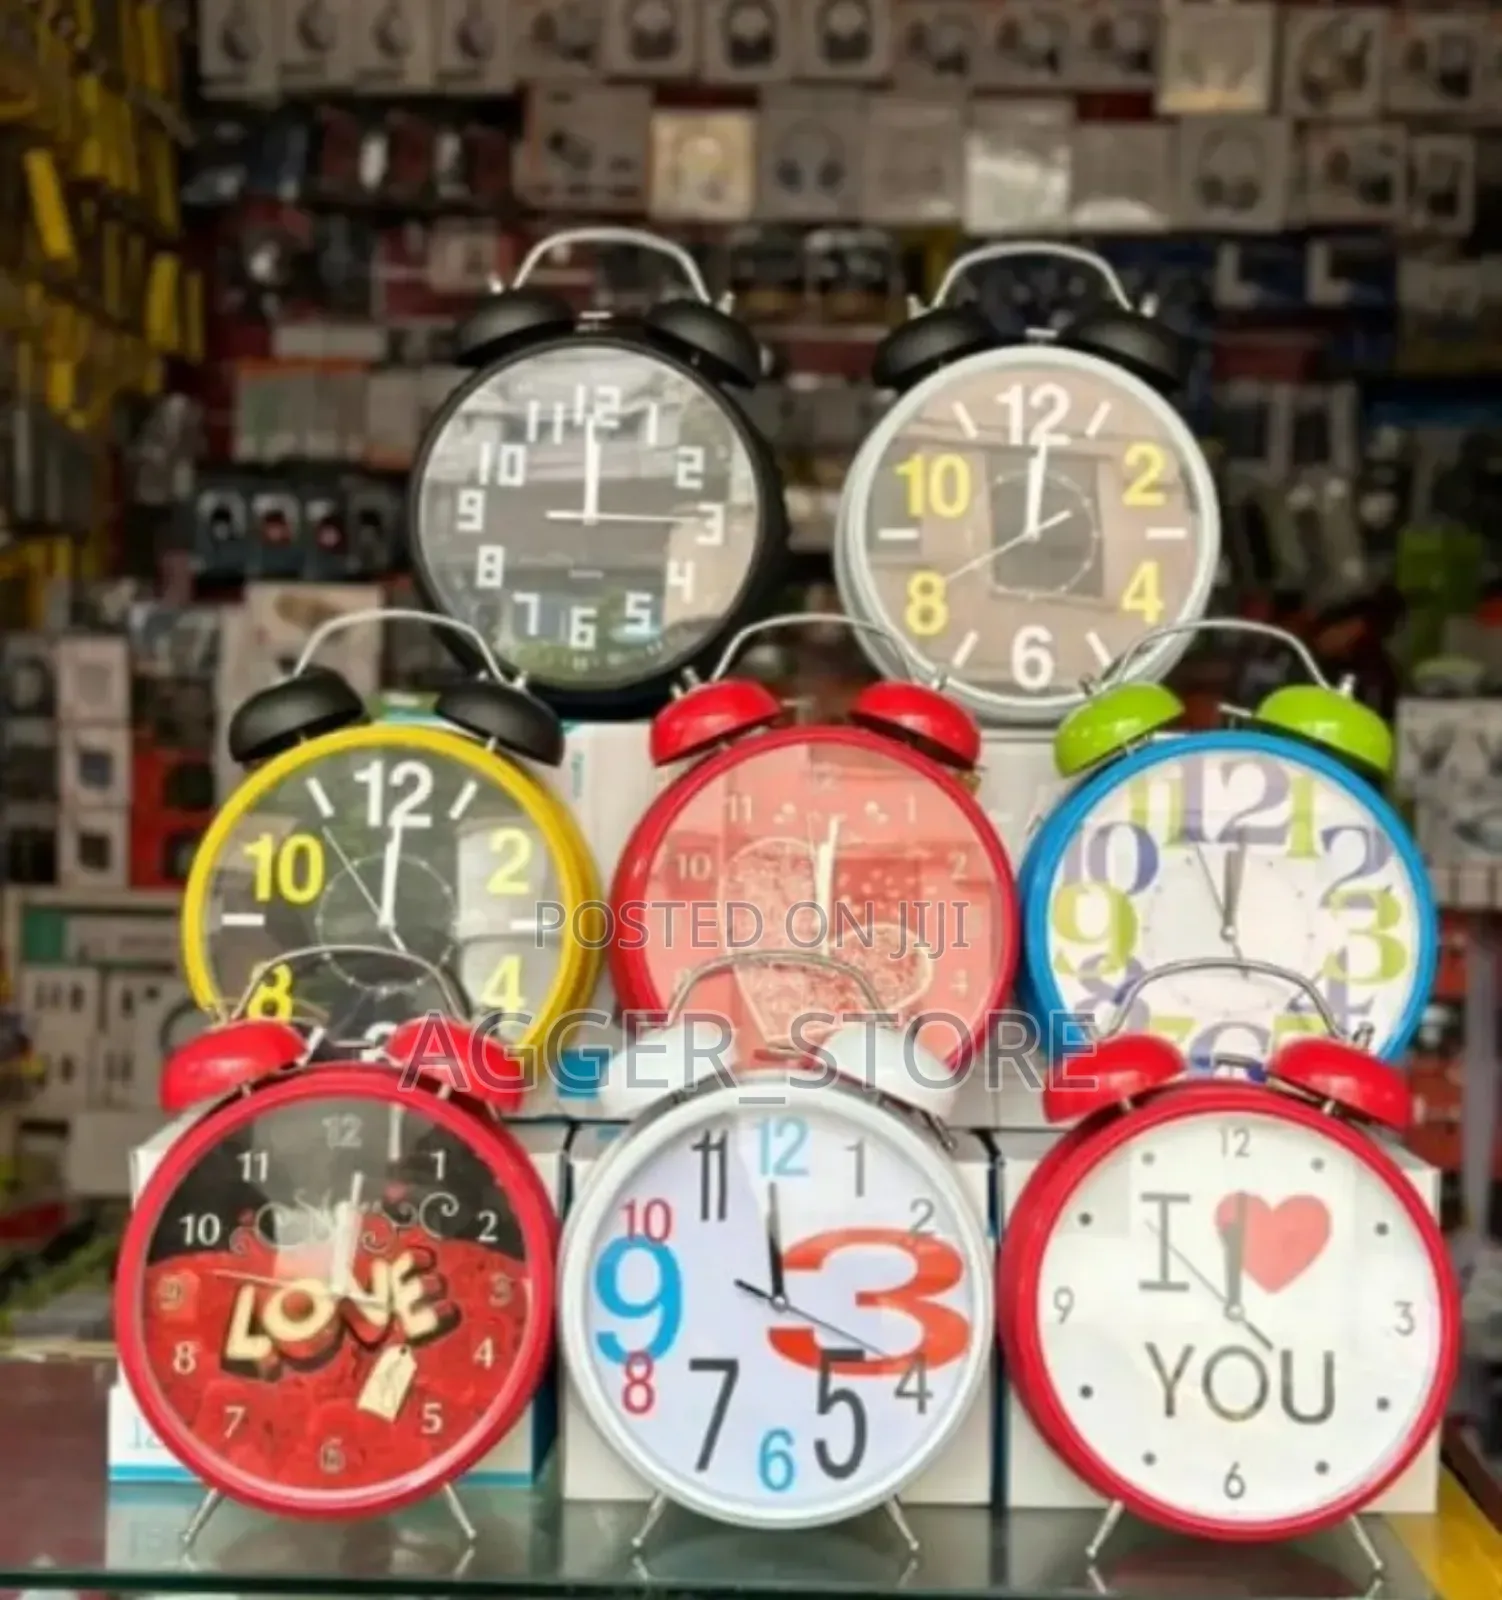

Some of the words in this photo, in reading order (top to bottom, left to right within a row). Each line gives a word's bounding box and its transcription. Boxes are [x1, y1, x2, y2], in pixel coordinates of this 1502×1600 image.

[528, 399, 564, 444] 11
[574, 384, 620, 428] 12
[646, 402, 658, 447] 1
[996, 383, 1071, 446] 12
[479, 442, 526, 486] 10
[675, 446, 704, 489] 2
[895, 453, 970, 517] 10
[1122, 443, 1166, 506] 2
[457, 489, 485, 531] 9
[695, 503, 724, 545] 3
[476, 545, 504, 588] 8
[667, 560, 694, 604] 4
[512, 593, 540, 635] 7
[624, 593, 652, 634] 5
[906, 570, 948, 635] 8
[1121, 560, 1164, 624] 4
[569, 606, 597, 650] 6
[1012, 625, 1054, 690] 6
[353, 759, 433, 828] 12
[729, 795, 753, 823] 11
[1181, 757, 1290, 844] 12
[1287, 775, 1320, 858] 1
[243, 833, 325, 904] 10
[486, 828, 531, 894] 2
[676, 853, 711, 881] 10
[1319, 825, 1396, 910] 2
[1053, 880, 1138, 975] 9
[1322, 887, 1408, 986] 3
[480, 954, 525, 1020] 4
[322, 1114, 363, 1149] 12
[756, 1117, 810, 1178] 12
[1217, 1126, 1252, 1159] 12
[237, 1152, 269, 1182] 11
[432, 1150, 446, 1181] 1
[690, 1129, 728, 1223] 11
[845, 1137, 866, 1198] 1
[180, 1214, 221, 1246] 10
[478, 1212, 499, 1244] 2
[621, 1198, 673, 1244] 10
[908, 1197, 937, 1237] 2
[1138, 1192, 1192, 1293] I
[222, 1247, 455, 1378] LOVE
[594, 1233, 685, 1365] 9
[767, 1226, 971, 1377] 3
[1053, 1286, 1076, 1325] 9
[1394, 1299, 1417, 1338] 3
[172, 1341, 198, 1375] 8
[474, 1337, 495, 1370] 4
[621, 1350, 657, 1416] 8
[894, 1351, 934, 1416] 4
[1144, 1340, 1336, 1425] YOU
[223, 1405, 247, 1438] 7
[421, 1404, 444, 1436] 5
[688, 1358, 739, 1473] 7
[813, 1348, 868, 1481] 5
[758, 1428, 796, 1493] 6
[1222, 1460, 1246, 1501] 6
